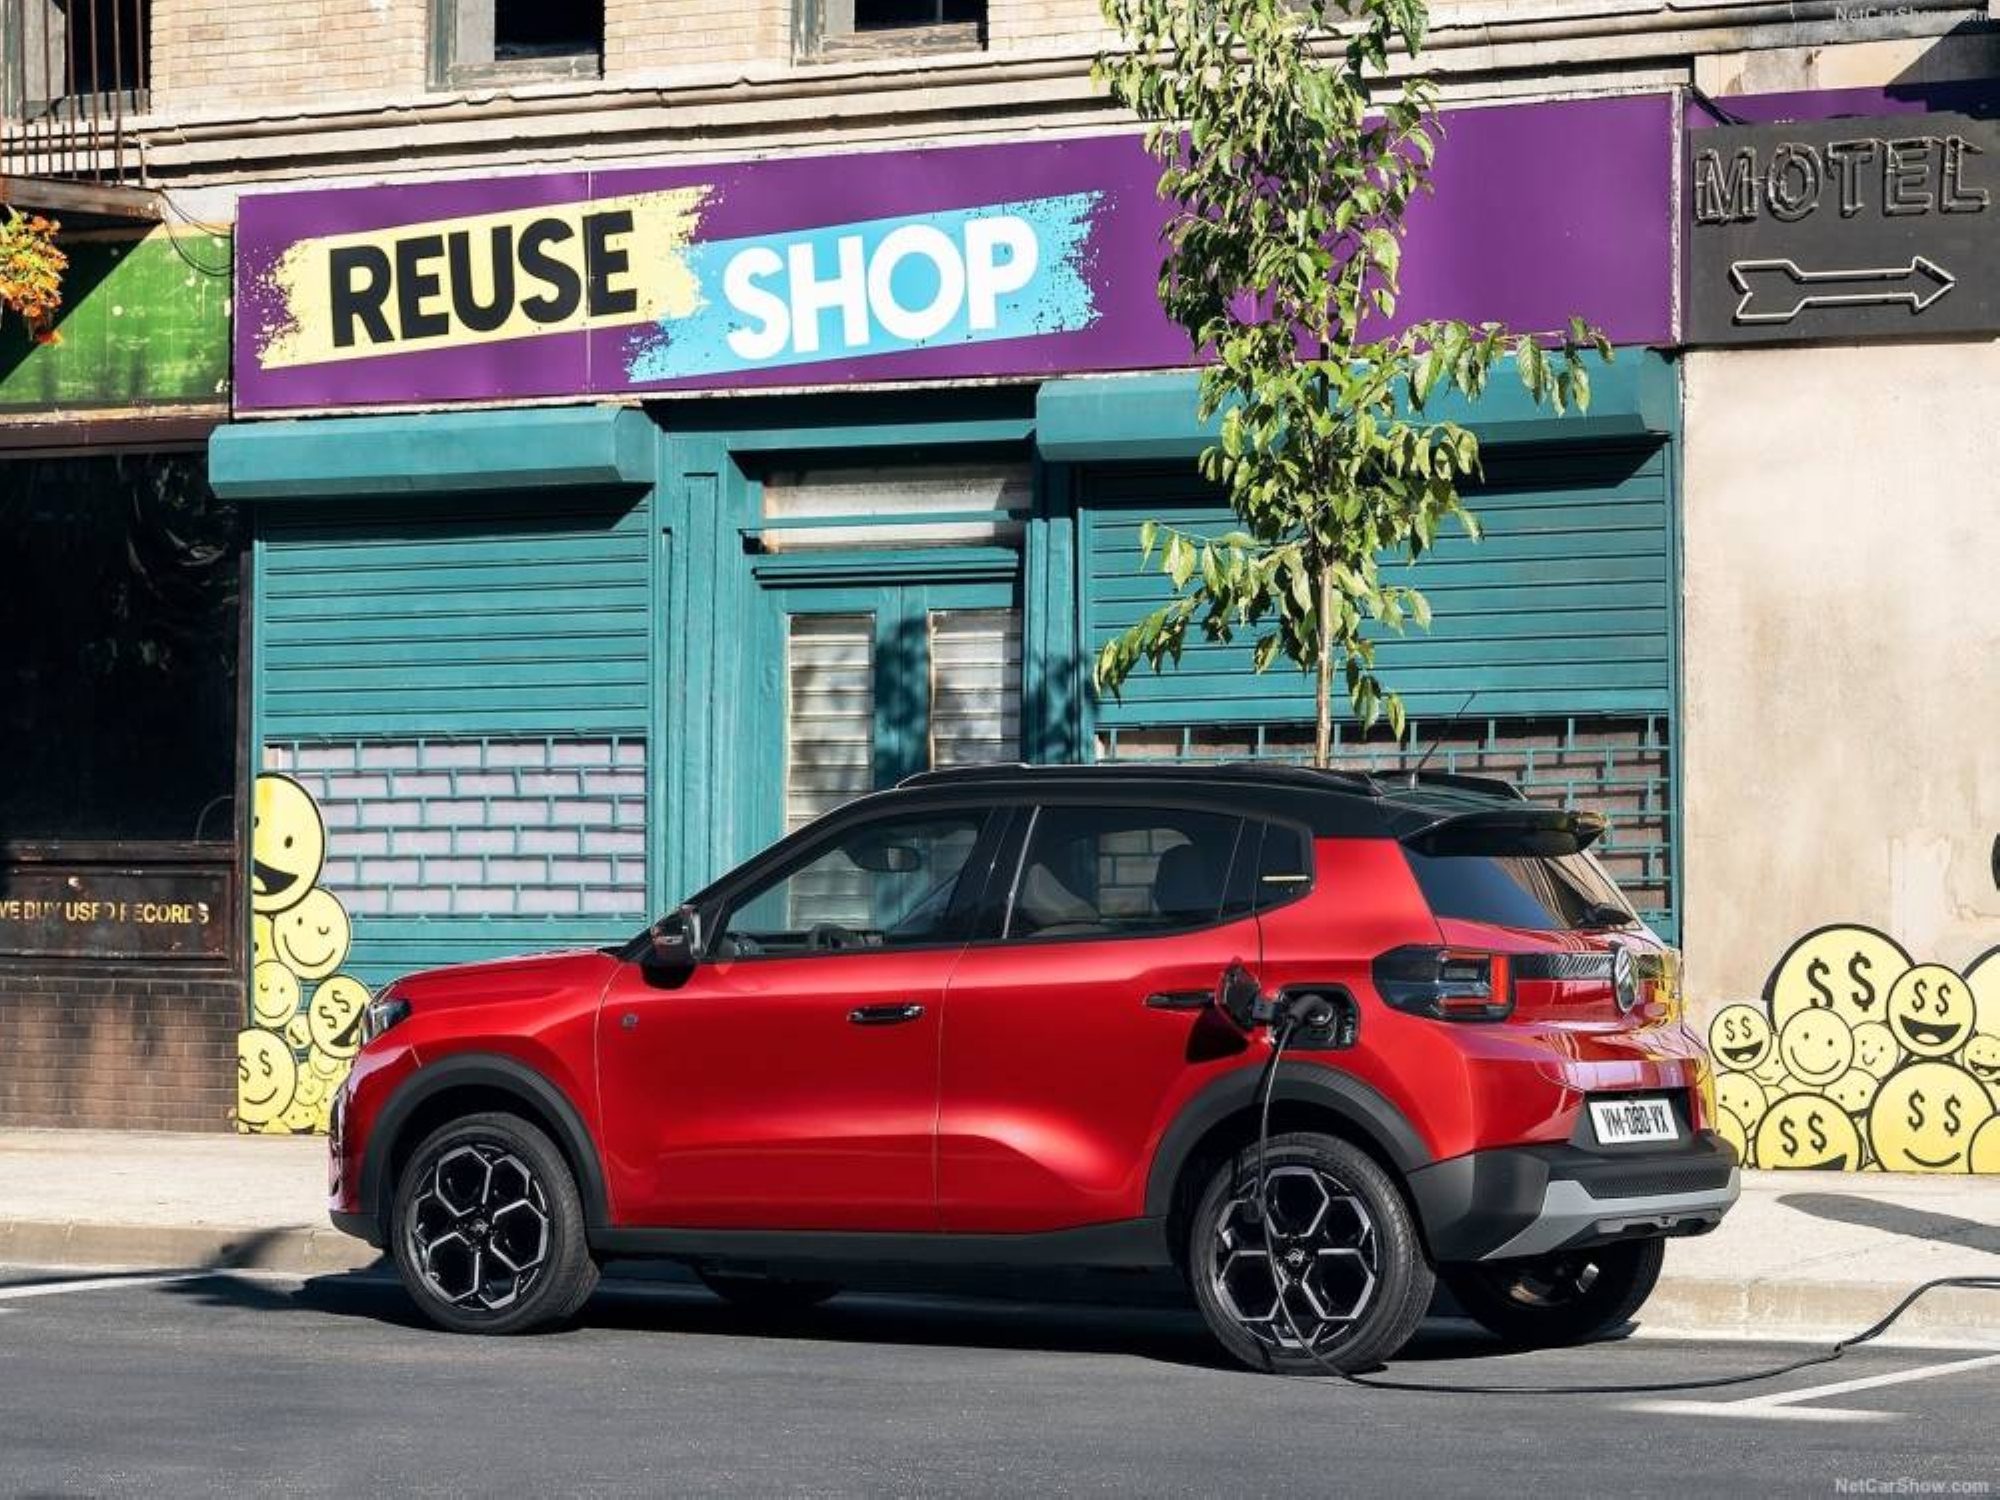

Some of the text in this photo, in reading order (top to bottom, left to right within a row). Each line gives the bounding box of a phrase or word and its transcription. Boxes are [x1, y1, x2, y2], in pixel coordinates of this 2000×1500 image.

[1694, 135, 1990, 225] MOTEL
[329, 210, 1039, 360] REUSE SHOP
